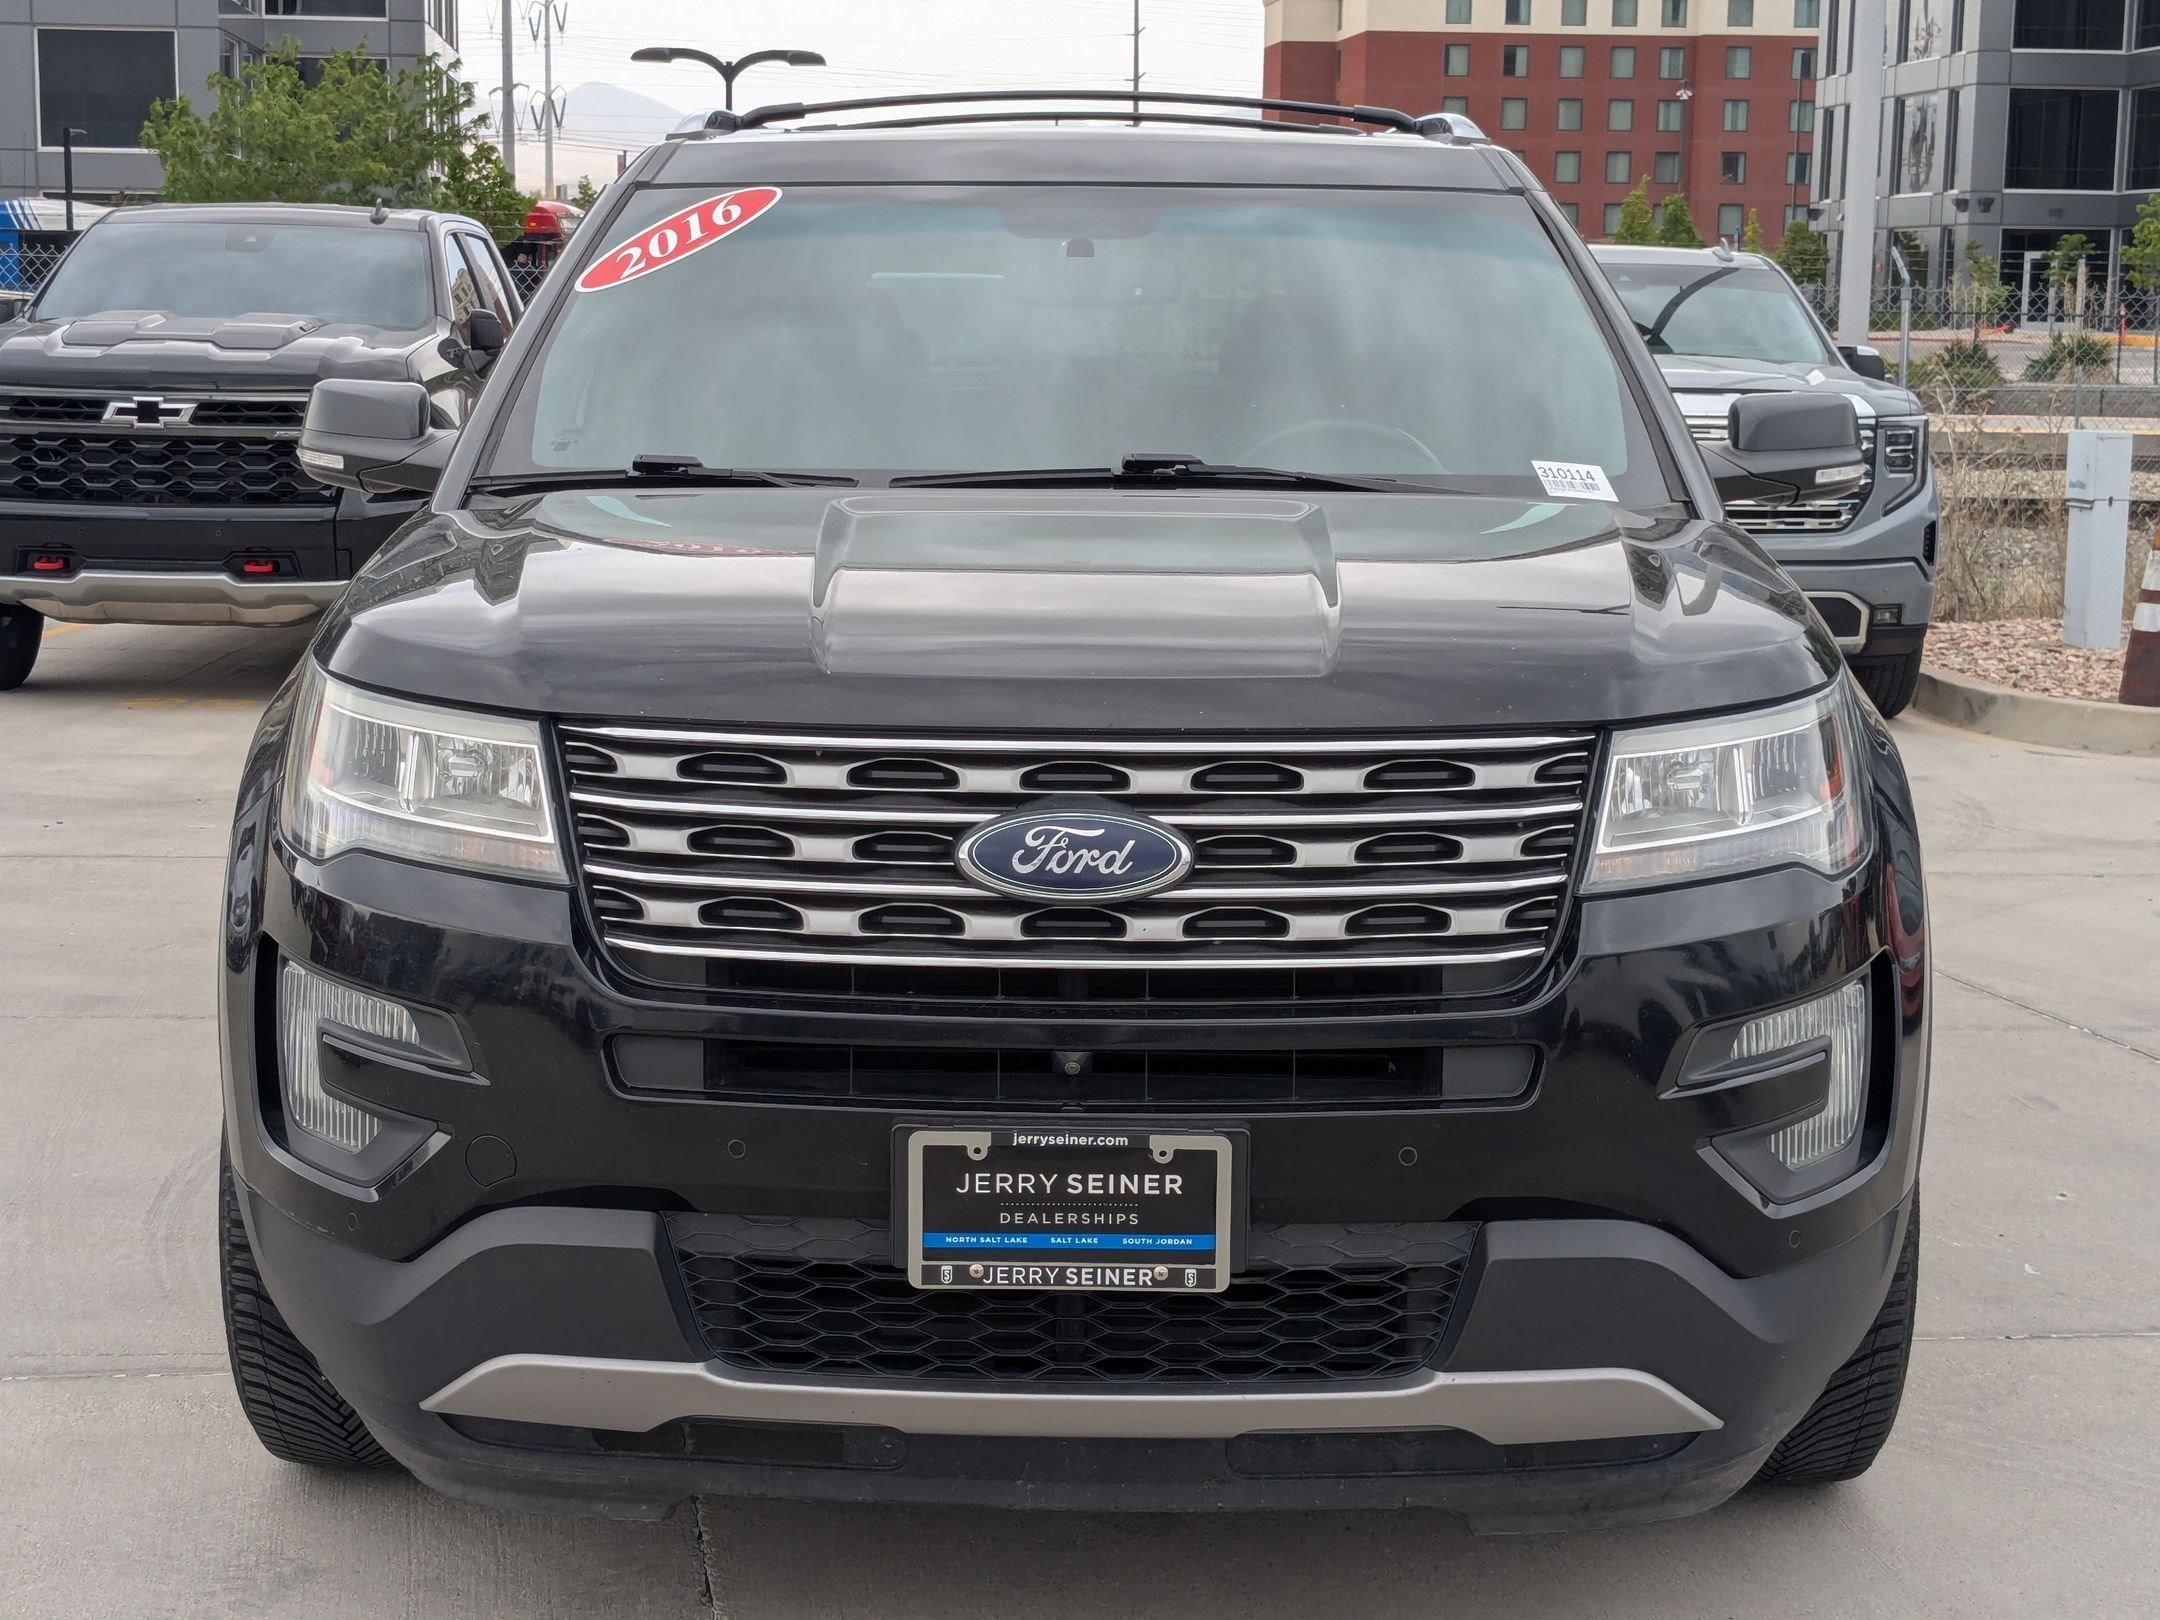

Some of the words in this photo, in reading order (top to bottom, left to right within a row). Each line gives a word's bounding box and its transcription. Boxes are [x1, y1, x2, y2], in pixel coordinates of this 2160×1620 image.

[616, 194, 742, 279] 2016
[1538, 466, 1596, 482] 310114
[1011, 825, 1136, 875] Ford
[1012, 1132, 1129, 1147] jerryseiner.com
[956, 1173, 1058, 1194] JERRY
[1066, 1173, 1183, 1195] SEINER
[1000, 1212, 1139, 1225] DEALERSHIPS
[980, 1236, 1000, 1244] SALT
[1004, 1236, 1028, 1244] LAKE
[1155, 1238, 1193, 1246] JORDAN
[983, 1266, 1060, 1285] JERRY
[1065, 1267, 1153, 1286] SEINER
